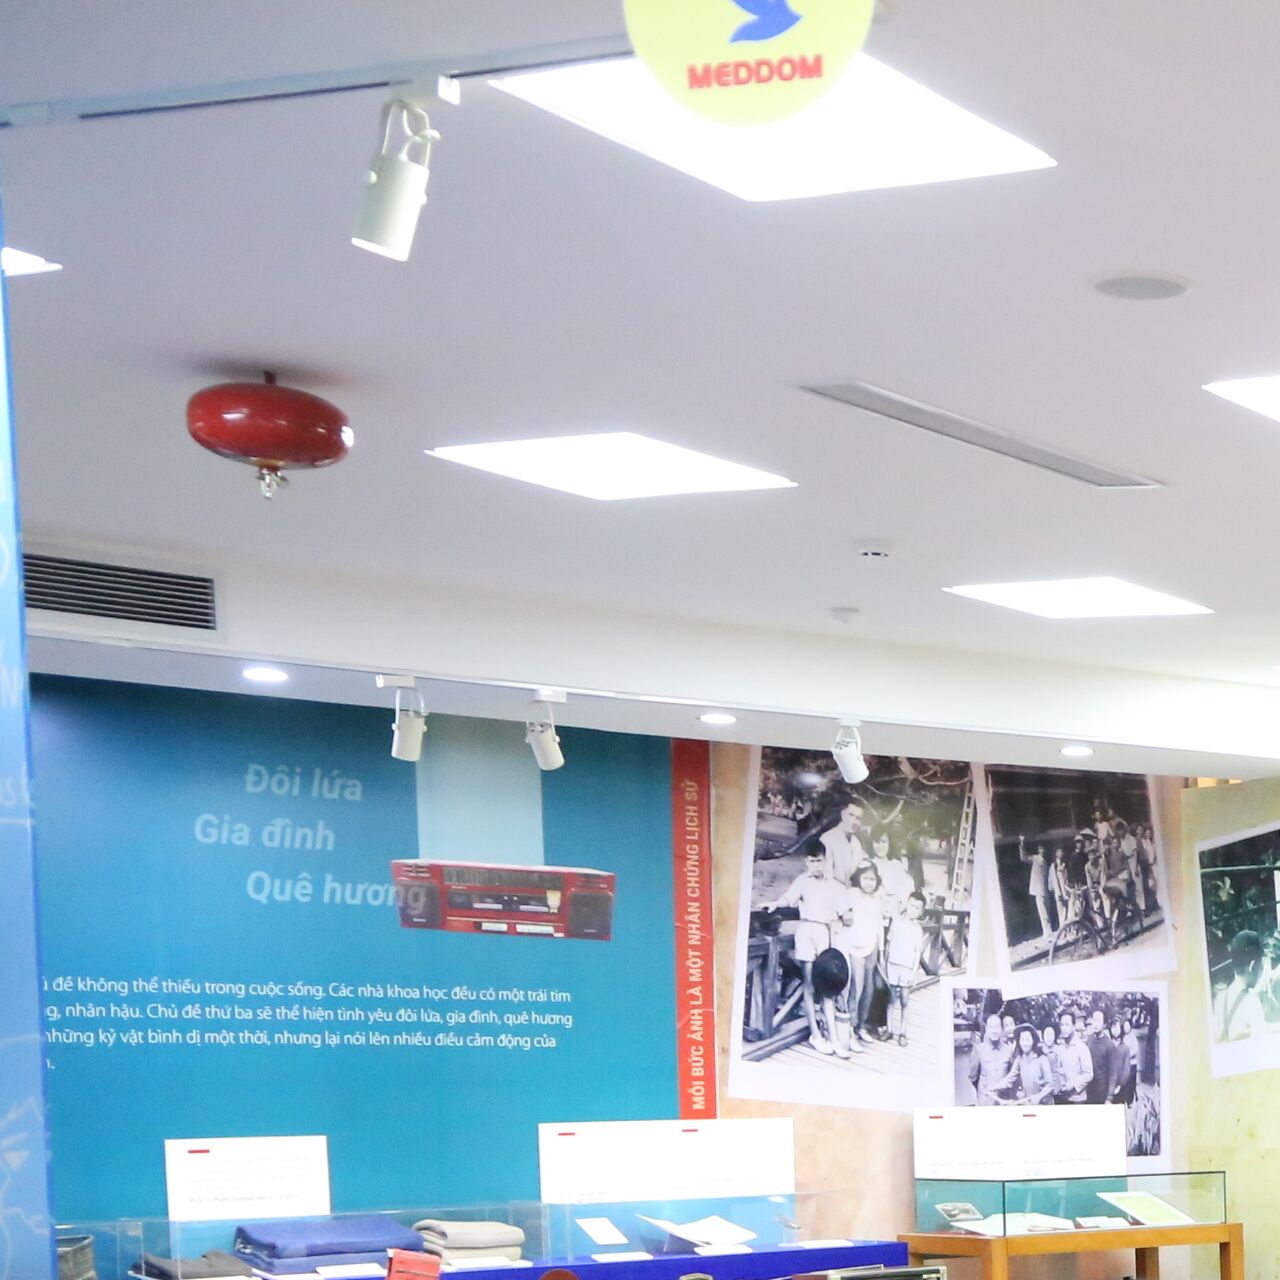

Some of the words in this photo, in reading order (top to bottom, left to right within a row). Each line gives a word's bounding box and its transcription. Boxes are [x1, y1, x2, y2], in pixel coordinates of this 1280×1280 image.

[687, 54, 822, 89] MEDDOM
[245, 763, 300, 796] Đôi
[312, 768, 362, 801] lứa
[681, 779, 698, 800] SỬ
[194, 813, 249, 846] Gia
[262, 817, 335, 851] đình
[685, 807, 701, 840] LỊCH
[683, 844, 700, 898] CHỨNG
[246, 871, 313, 904] Quê
[324, 873, 427, 916] hương
[685, 902, 701, 945] NHÂN
[686, 949, 704, 982] MỘT
[686, 986, 703, 1005] LÀ
[687, 1011, 703, 1041] ẢNH
[688, 1046, 705, 1076] BỨC
[688, 1081, 705, 1110] MỖI
